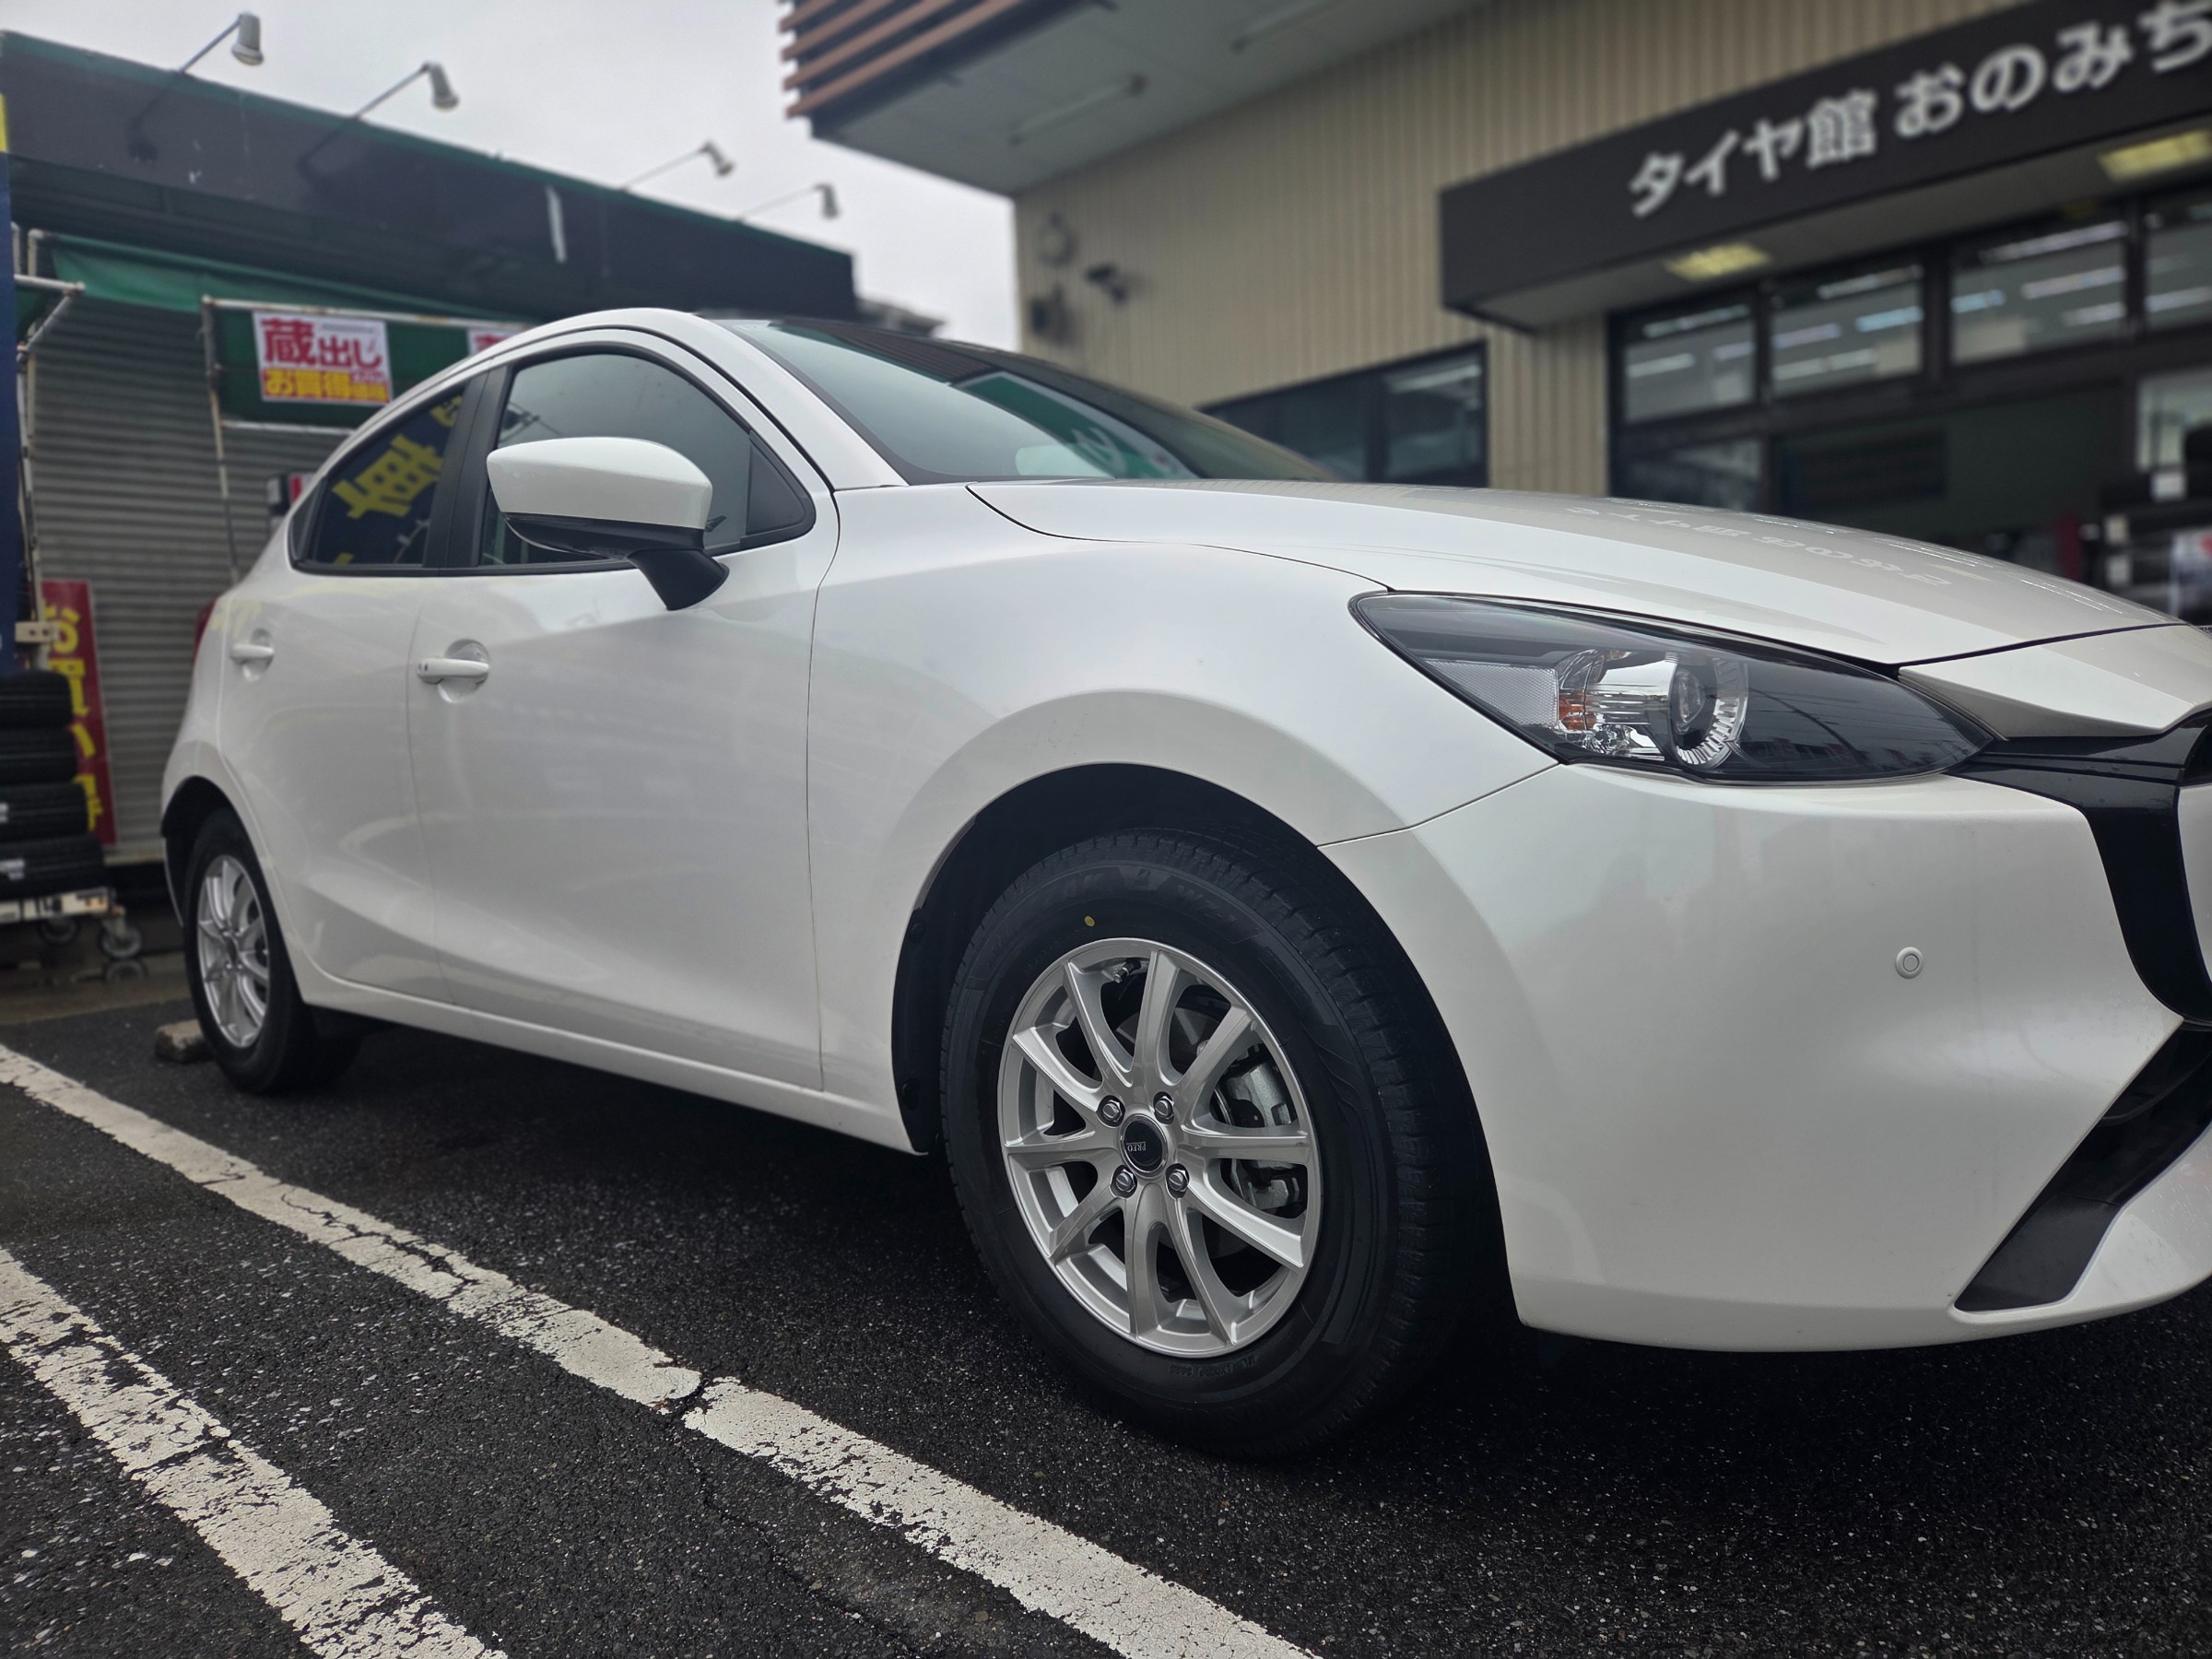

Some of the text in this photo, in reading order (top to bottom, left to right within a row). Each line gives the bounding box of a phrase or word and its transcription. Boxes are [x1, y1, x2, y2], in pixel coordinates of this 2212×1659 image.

[1629, 0, 2212, 218] タイヤ館 おのみち
[261, 317, 383, 370] 蔵出し
